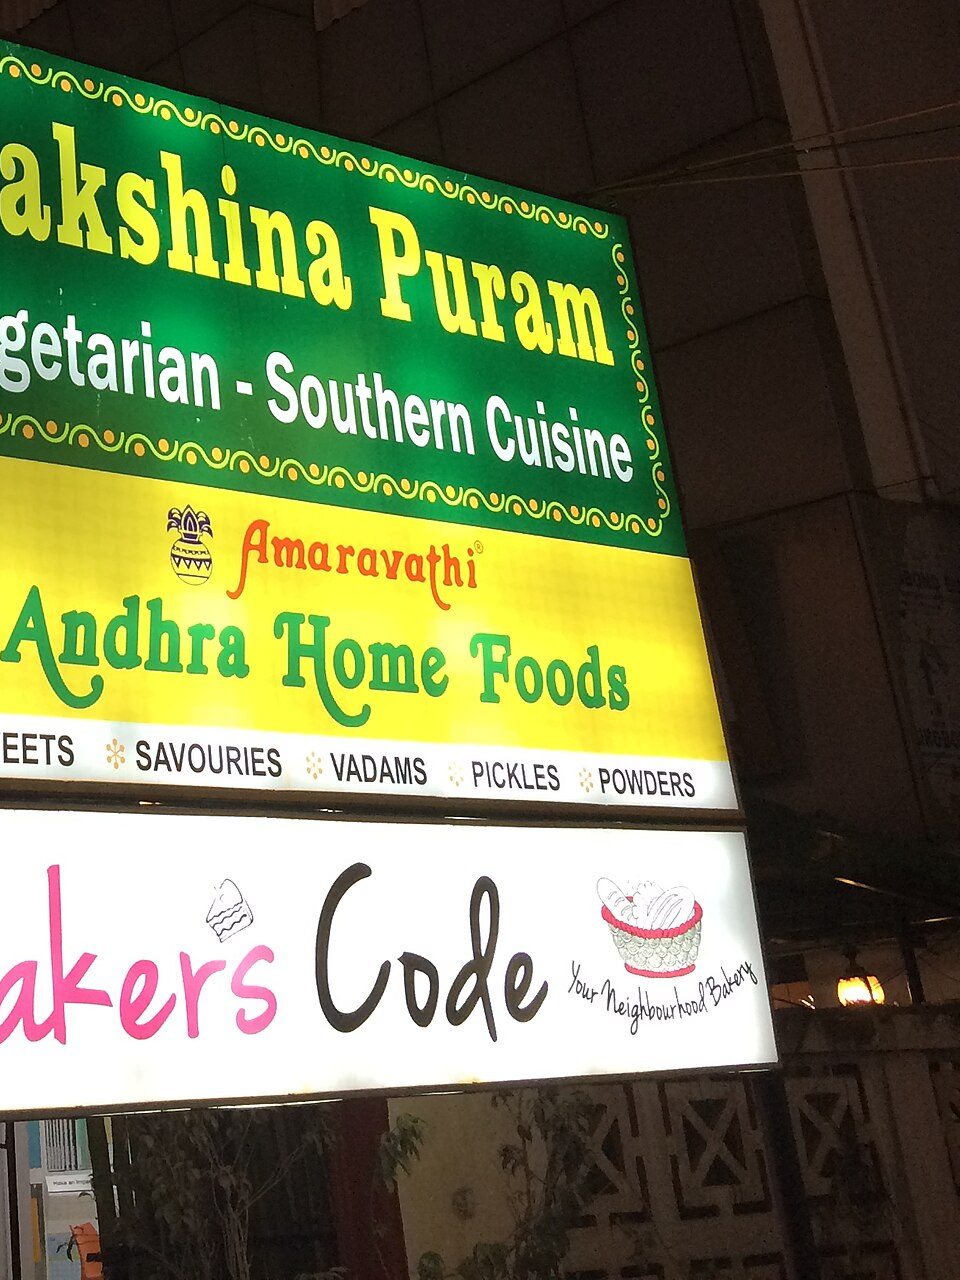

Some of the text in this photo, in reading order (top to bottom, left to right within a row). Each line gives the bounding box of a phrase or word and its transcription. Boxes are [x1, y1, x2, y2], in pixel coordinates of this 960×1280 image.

[369, 206, 615, 366] Puram
[265, 352, 476, 456] Southern
[485, 395, 634, 483] Cuisine
[0, 585, 631, 728] Andhra Home Foods
[136, 740, 282, 777] SAVOURIES
[330, 752, 428, 786] VADAMS
[471, 760, 561, 792] PICKLES
[599, 767, 695, 798] POWDERS
[315, 862, 548, 1042] Code
[568, 960, 758, 1035] Your Neighbourhood Bakery
